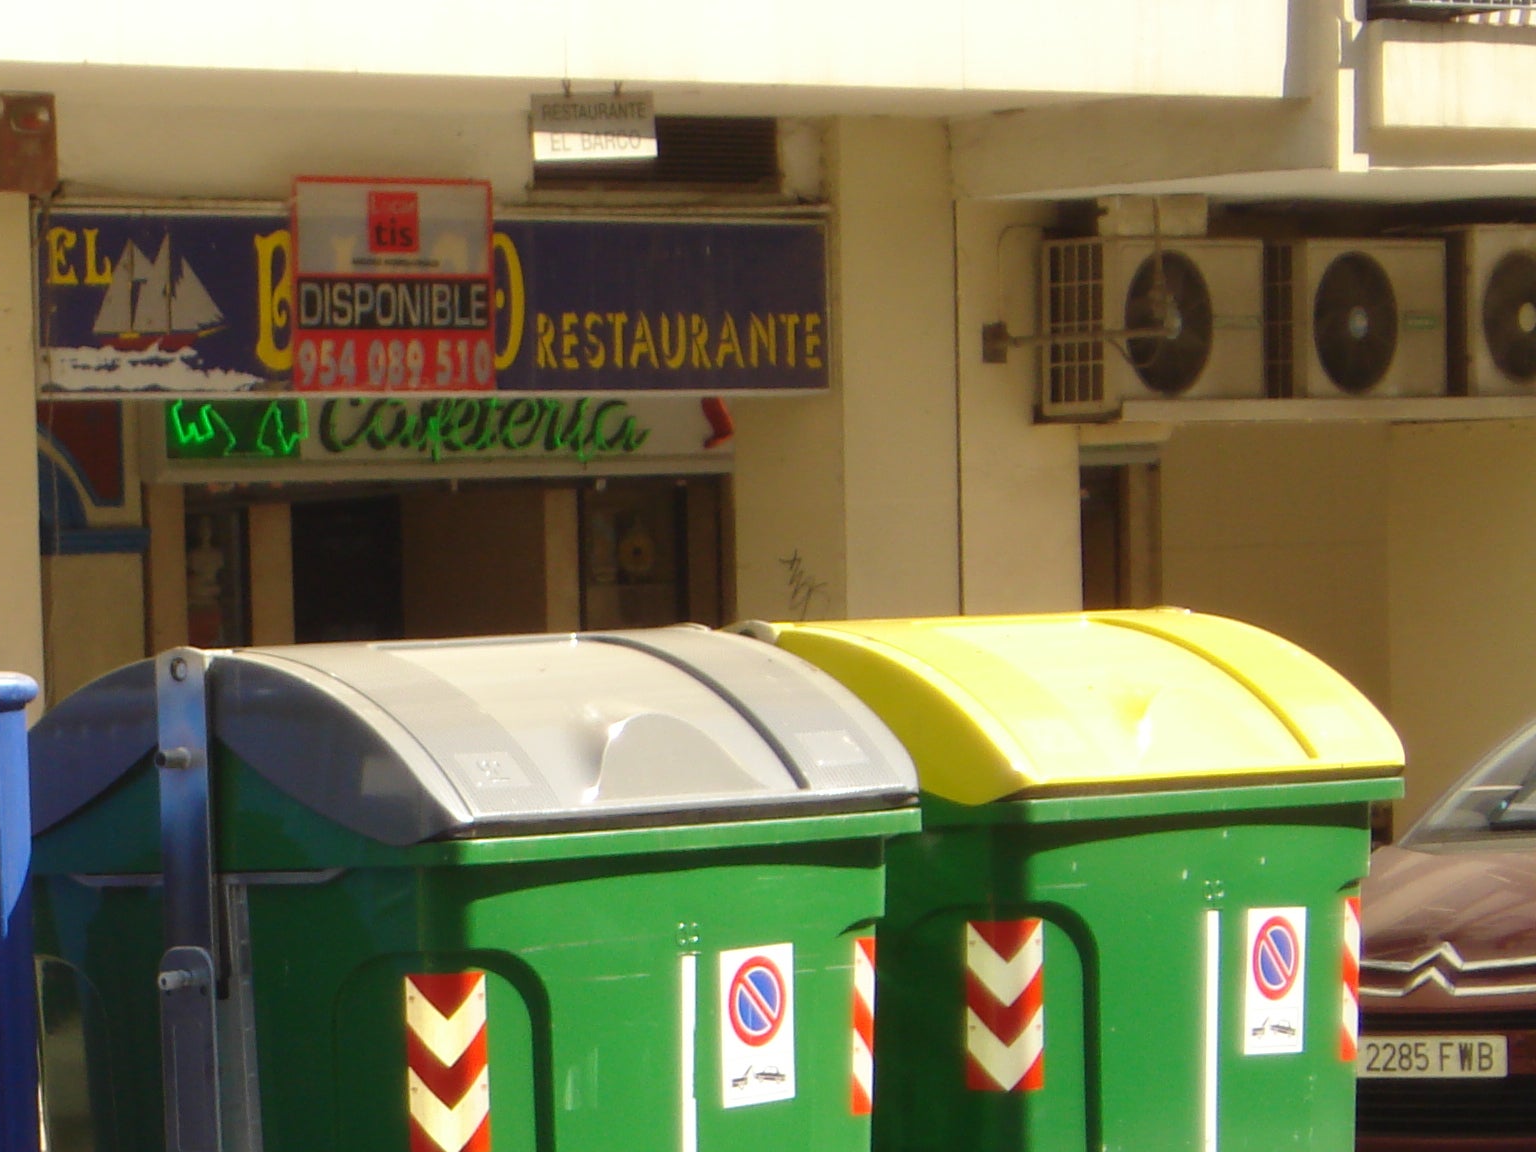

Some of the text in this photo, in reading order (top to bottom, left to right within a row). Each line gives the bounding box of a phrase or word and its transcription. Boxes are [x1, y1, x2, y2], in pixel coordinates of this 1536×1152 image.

[541, 102, 647, 121] RESTAURANTE
[550, 128, 642, 152] EL BARCO
[46, 226, 114, 286] EL
[299, 282, 488, 328] DISPONIBLE
[299, 338, 357, 387] 954
[367, 338, 425, 388] 089
[536, 310, 823, 371] RESTAURANTE
[1366, 1042, 1494, 1072] 2285 FWB
